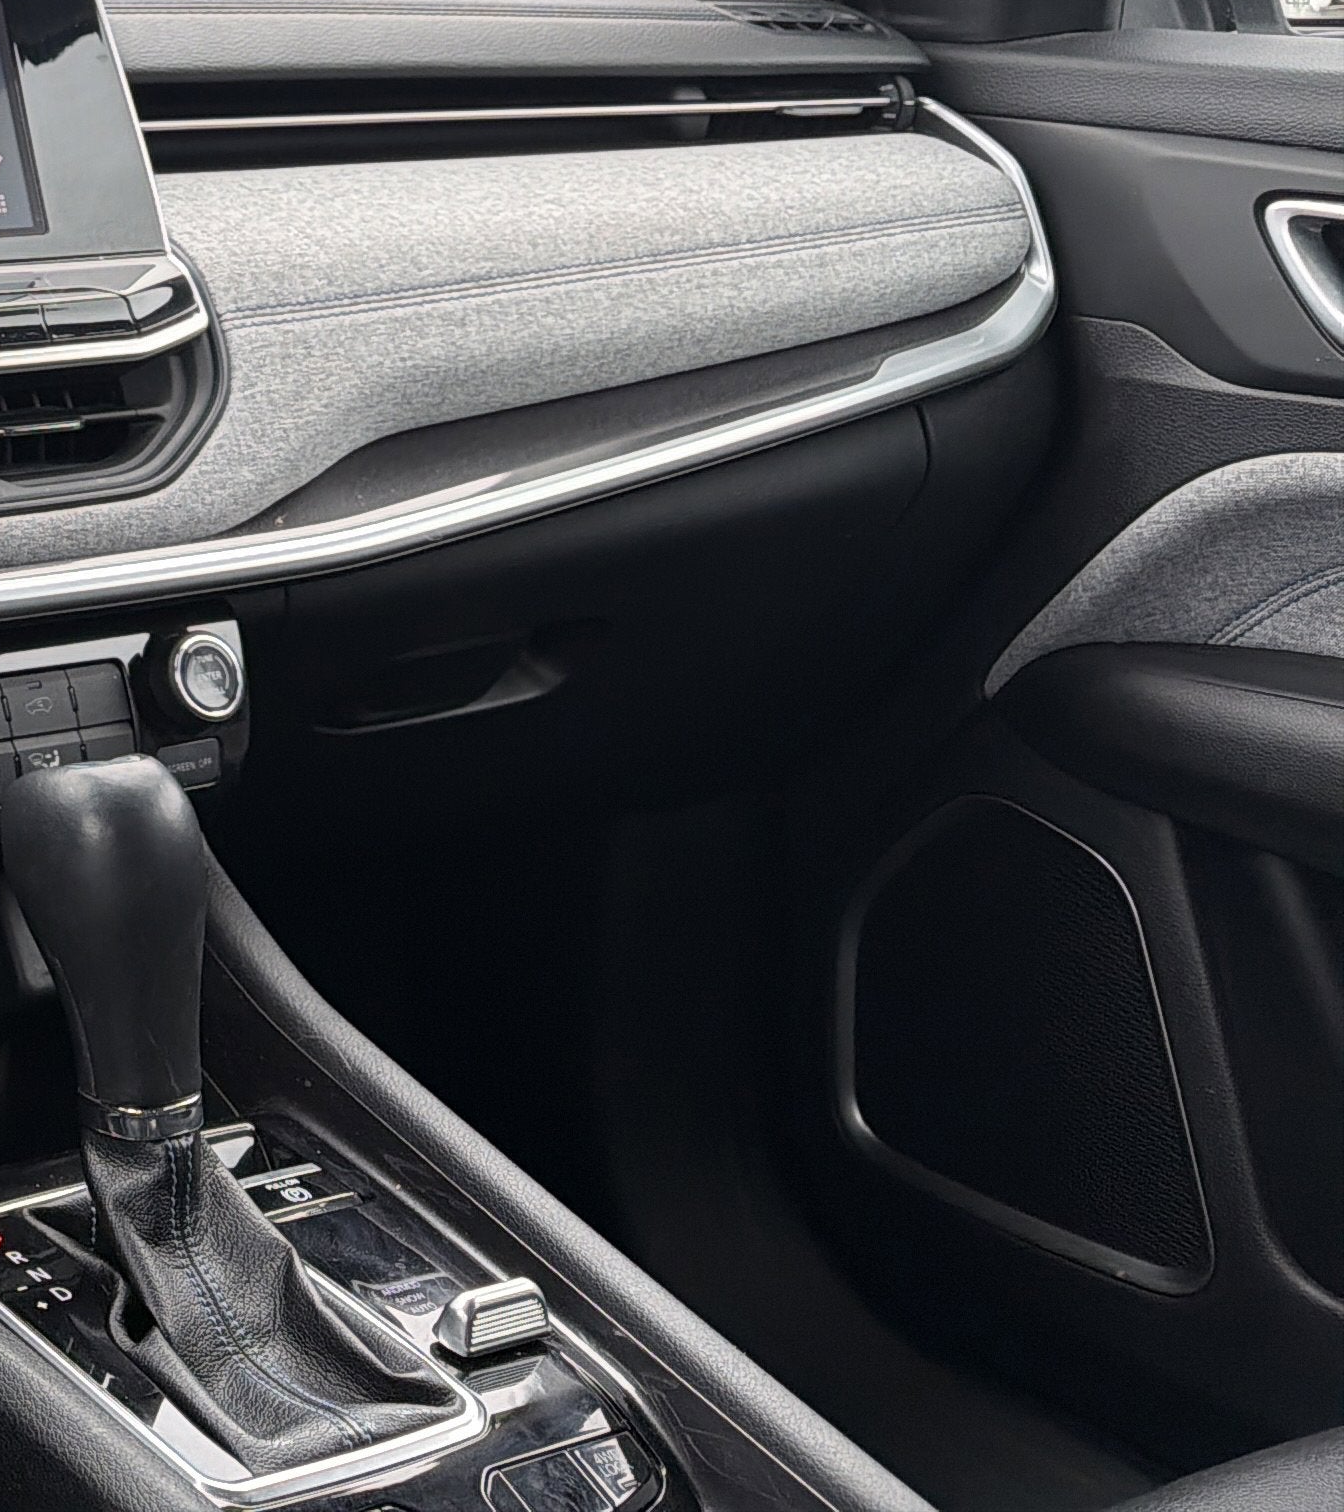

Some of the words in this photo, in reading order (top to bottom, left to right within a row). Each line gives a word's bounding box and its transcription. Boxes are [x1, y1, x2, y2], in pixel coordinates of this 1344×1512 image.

[5, 1251, 29, 1265] R
[25, 1267, 52, 1283] N
[49, 1287, 72, 1302] D
[410, 1302, 437, 1314] AUTO
